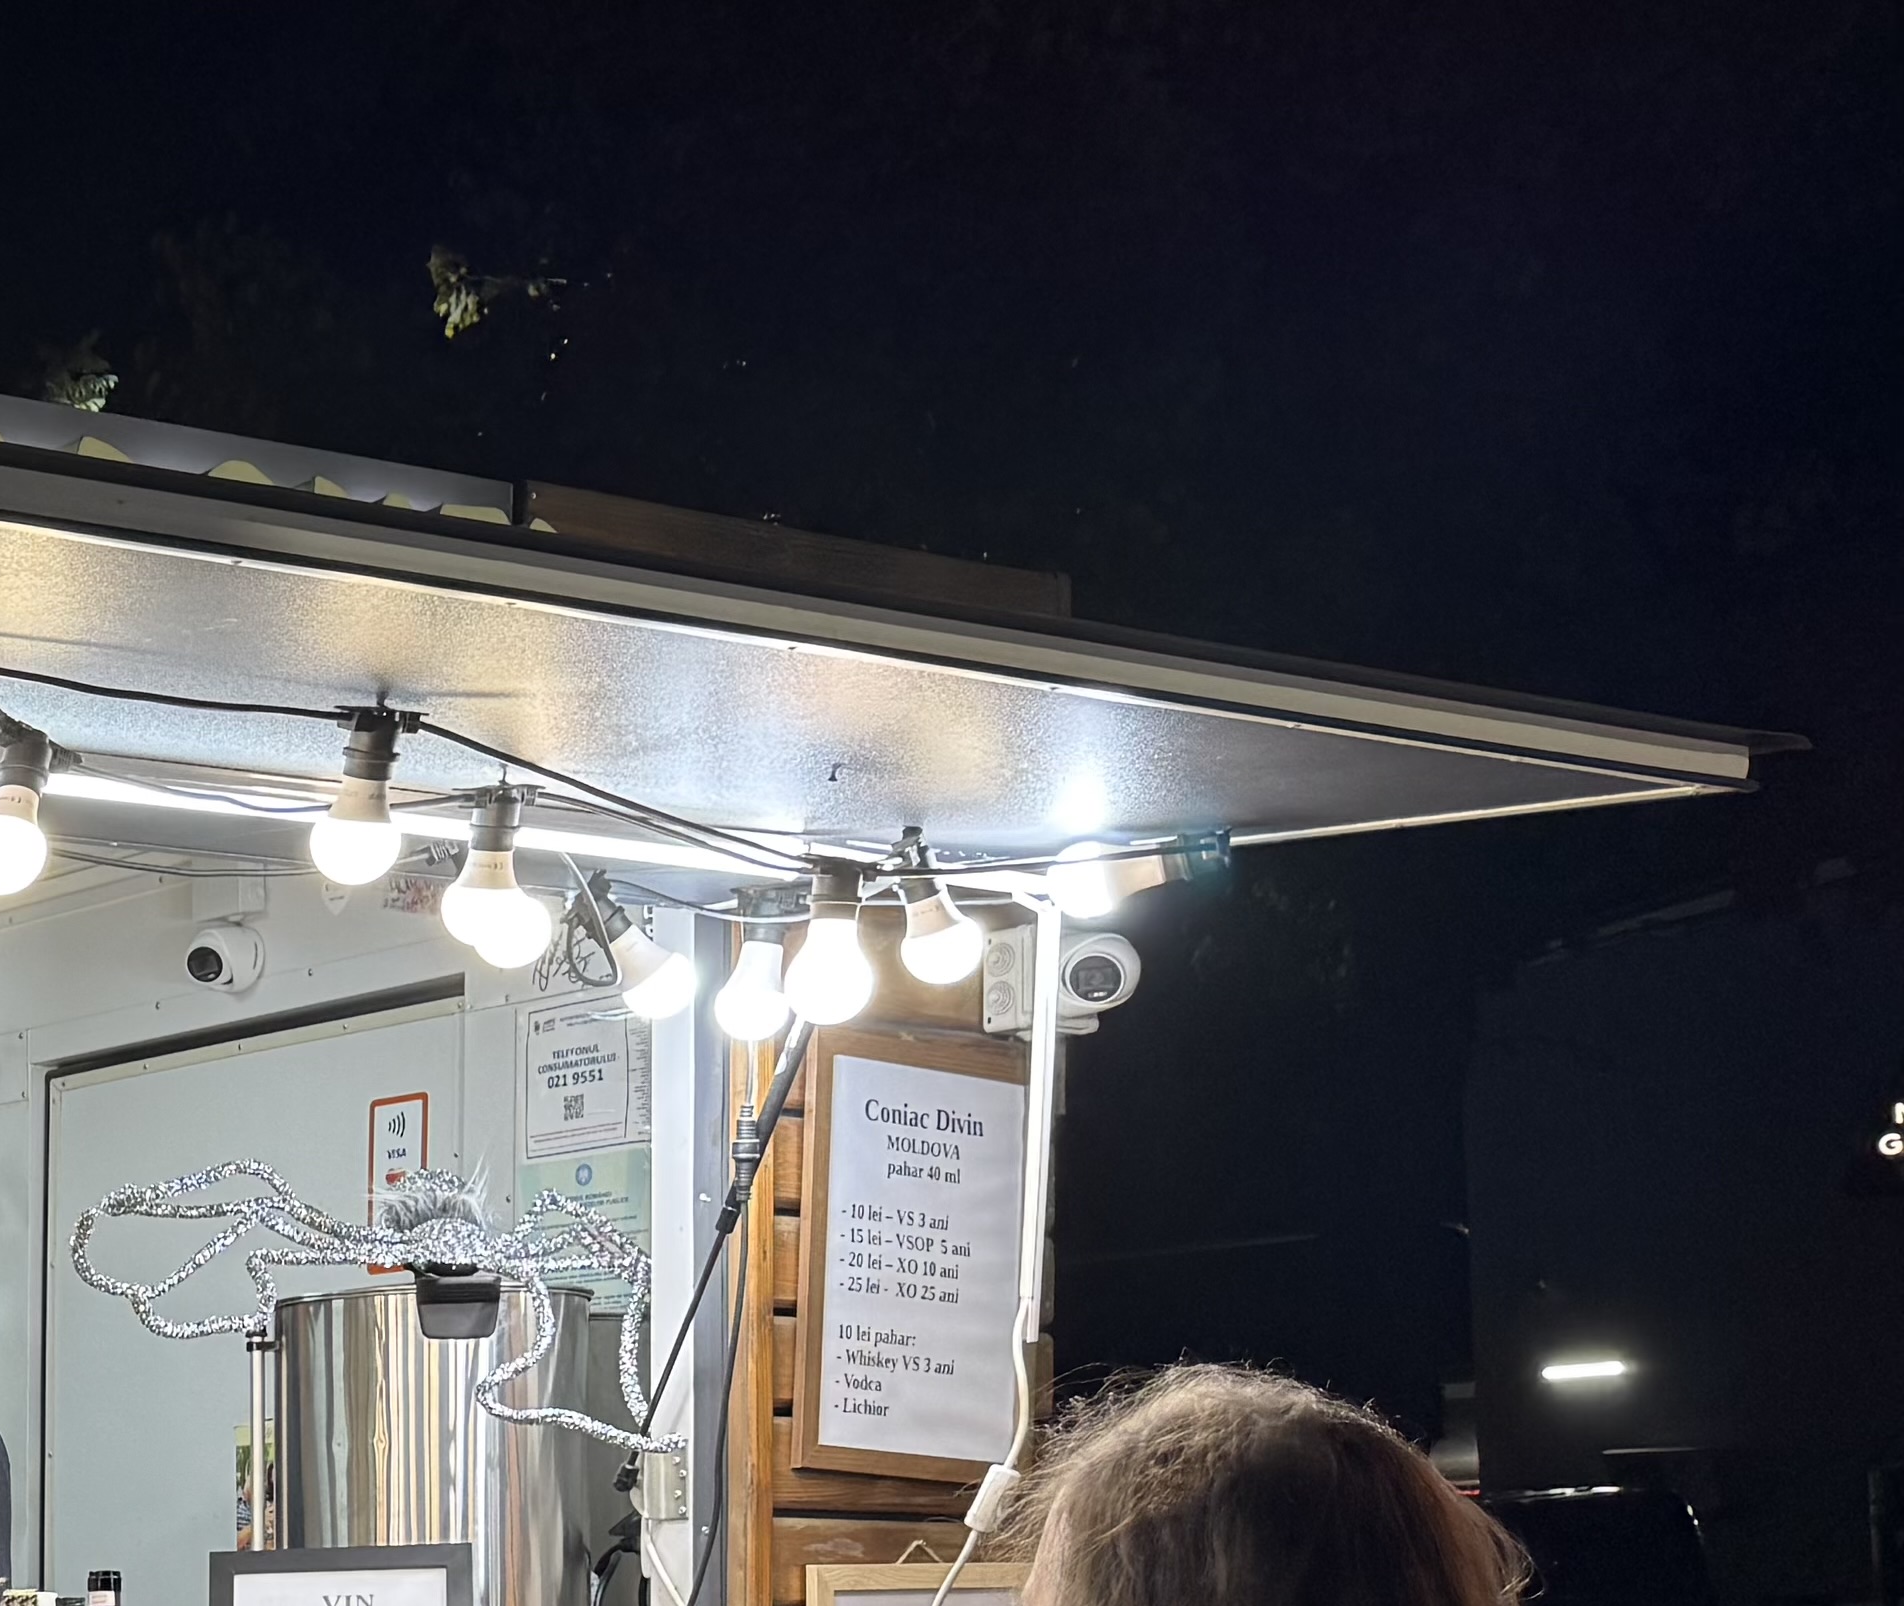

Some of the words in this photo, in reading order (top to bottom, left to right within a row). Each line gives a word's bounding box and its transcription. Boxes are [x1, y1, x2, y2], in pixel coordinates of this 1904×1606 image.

[548, 1074, 567, 1088] 021
[572, 1069, 603, 1085] 9551
[864, 1098, 930, 1130] Coniac
[935, 1108, 984, 1138] Divin
[887, 1134, 961, 1161] MOLDOVA
[886, 1160, 925, 1179] pahar
[926, 1165, 941, 1182] 40
[944, 1168, 961, 1185] ml
[851, 1203, 865, 1220] 10
[867, 1204, 883, 1223] lei
[896, 1209, 915, 1227] VS
[918, 1212, 926, 1229] 3
[928, 1215, 949, 1231] ani
[843, 1372, 882, 1392] Vodca
[842, 1397, 890, 1417] Lichior
